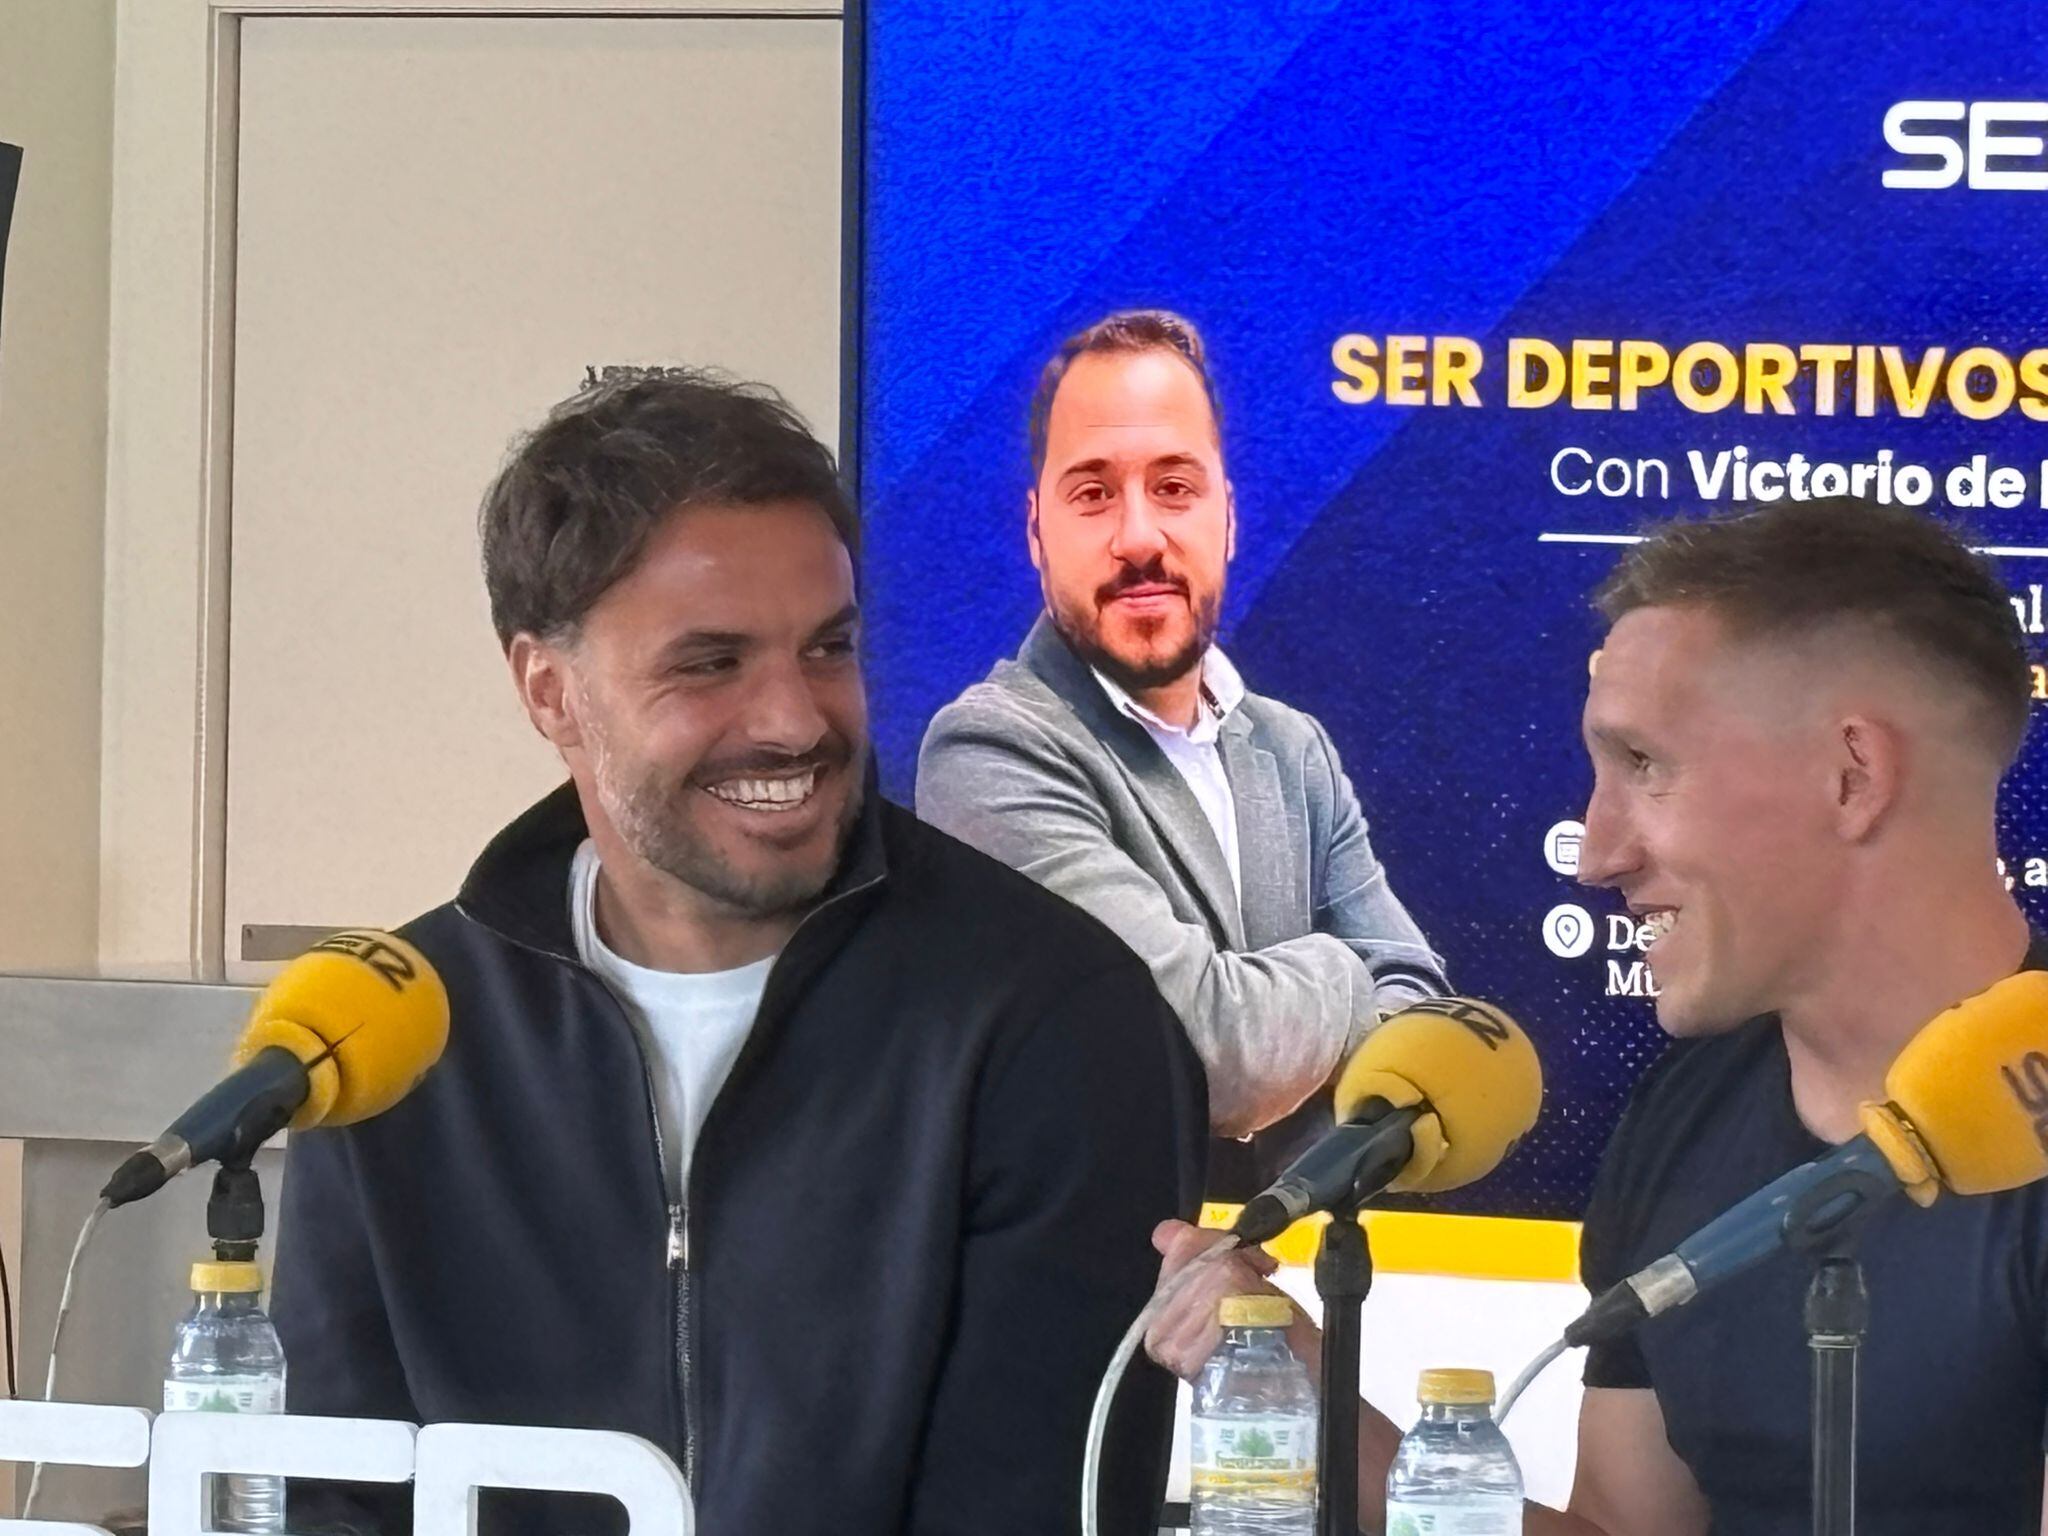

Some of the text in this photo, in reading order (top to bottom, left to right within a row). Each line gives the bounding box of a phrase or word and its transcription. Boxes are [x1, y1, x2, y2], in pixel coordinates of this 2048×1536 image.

[1331, 334, 2048, 421] SER DEPORTIVOS
[1550, 447, 1668, 498] Con
[1688, 445, 1933, 506] Victorio
[1945, 454, 2026, 509] de
